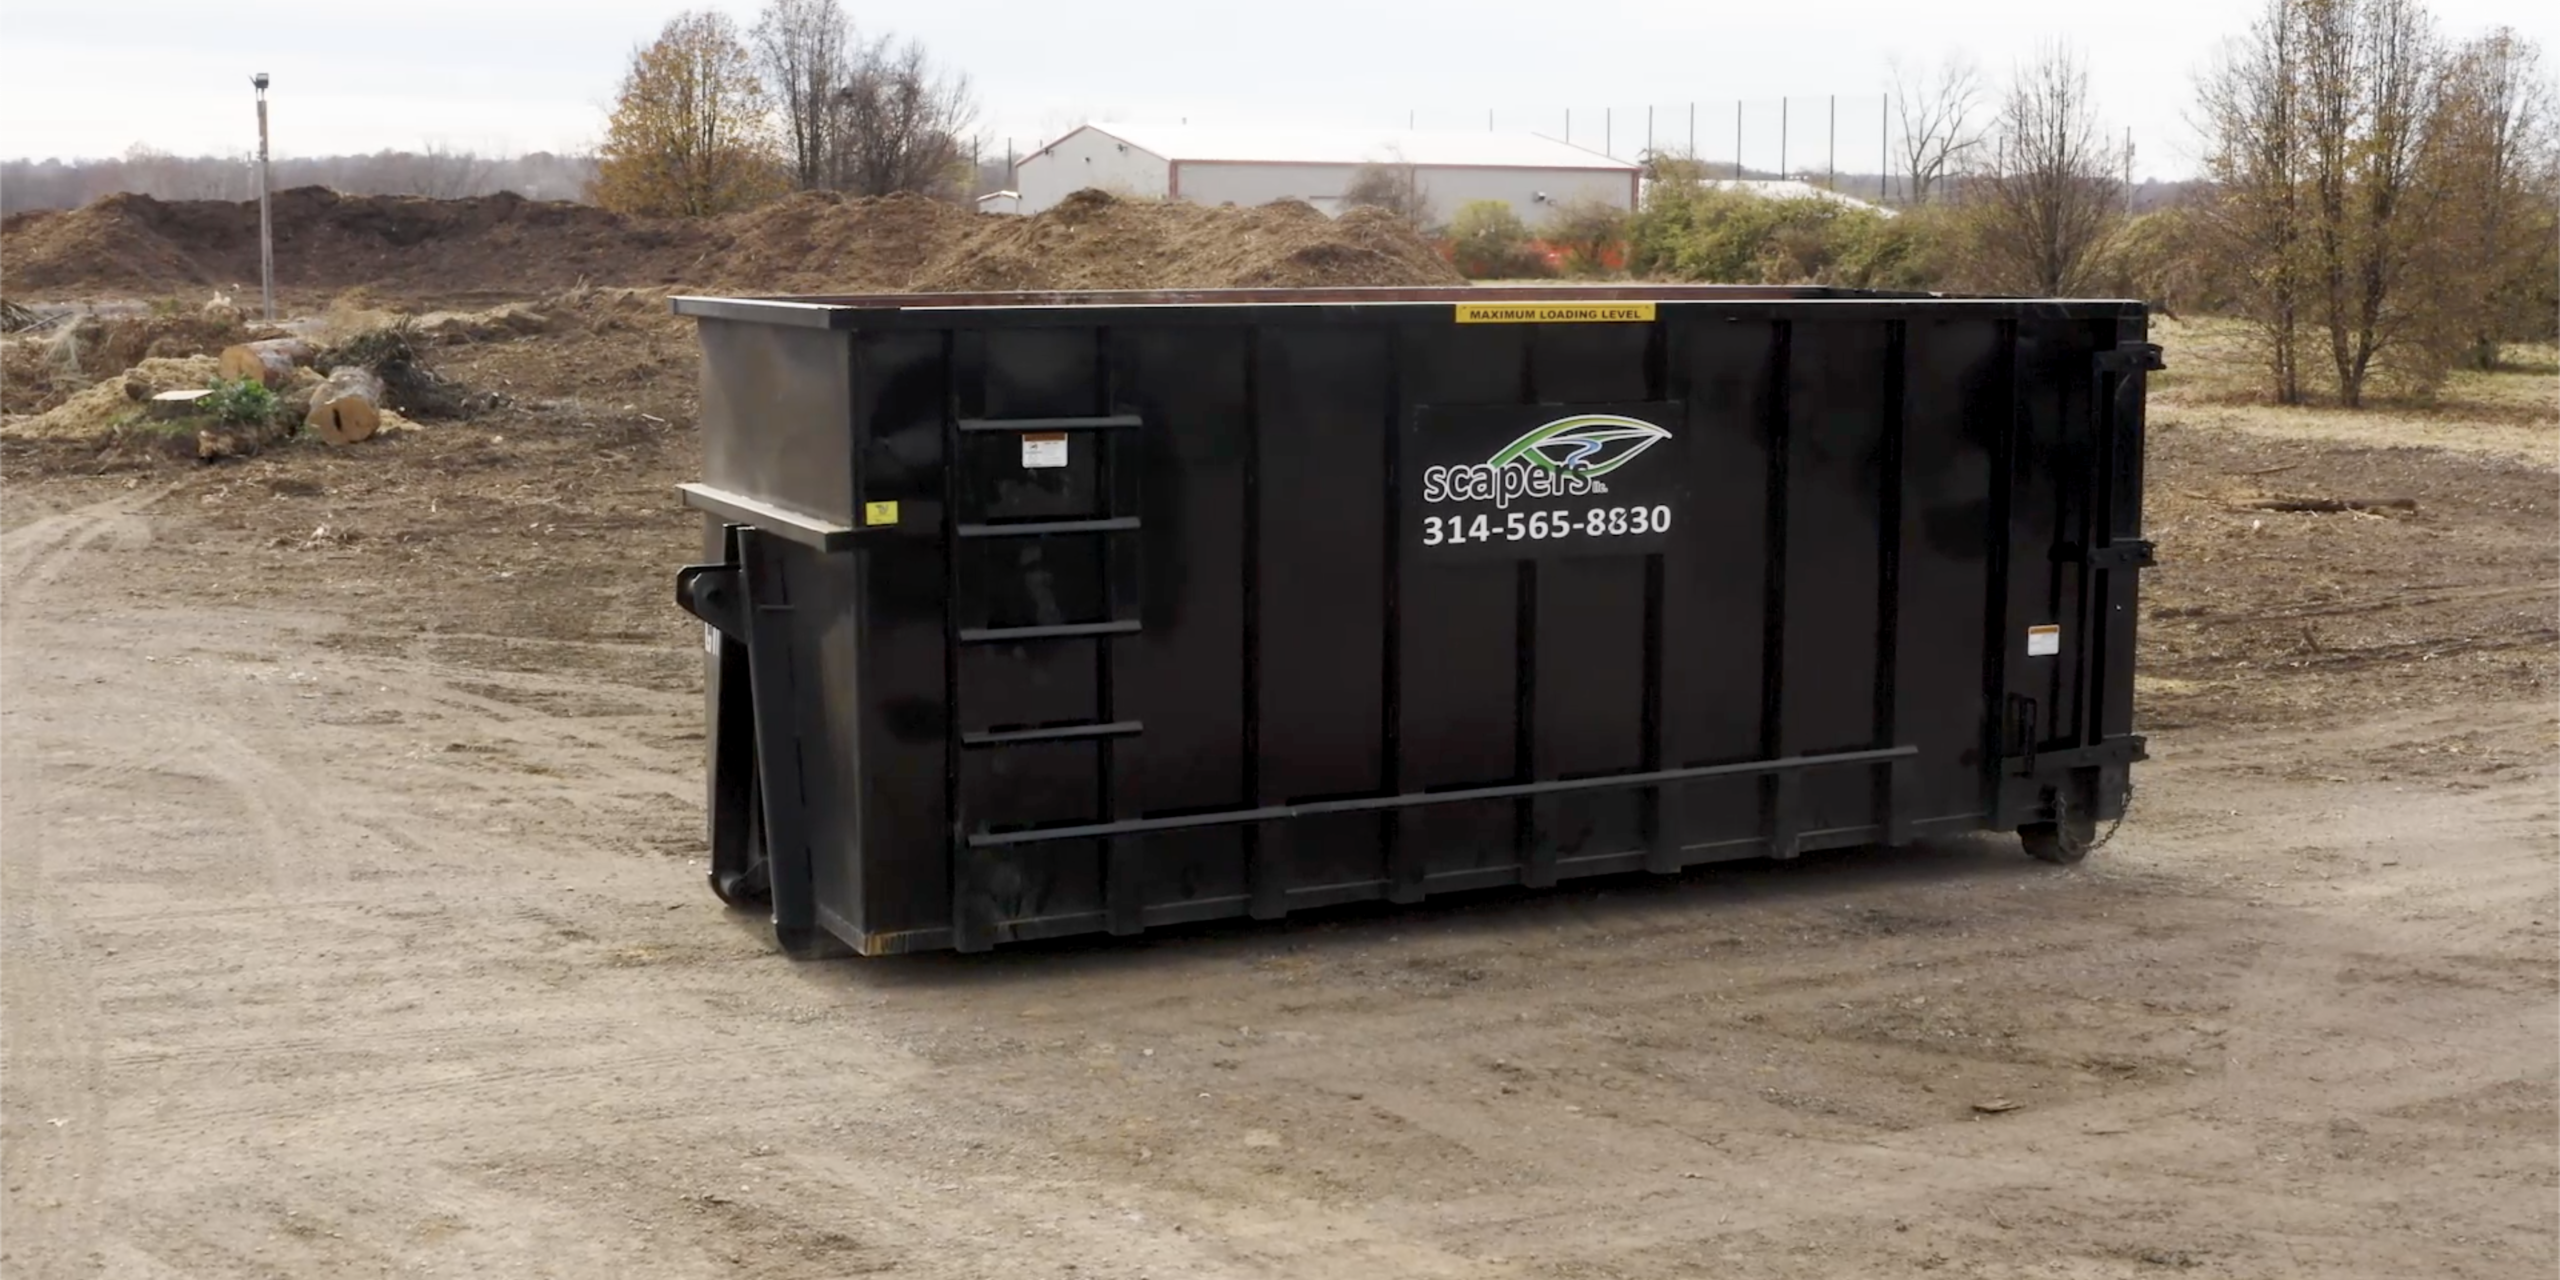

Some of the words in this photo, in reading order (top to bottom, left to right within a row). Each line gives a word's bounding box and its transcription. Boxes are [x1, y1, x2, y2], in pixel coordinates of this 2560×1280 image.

[1469, 309, 1536, 320] MAXIMUM
[1540, 309, 1598, 320] LOADING
[1601, 309, 1641, 319] LEVEL
[1423, 461, 1592, 509] scapers
[1423, 505, 1672, 545] 314-565-8830
